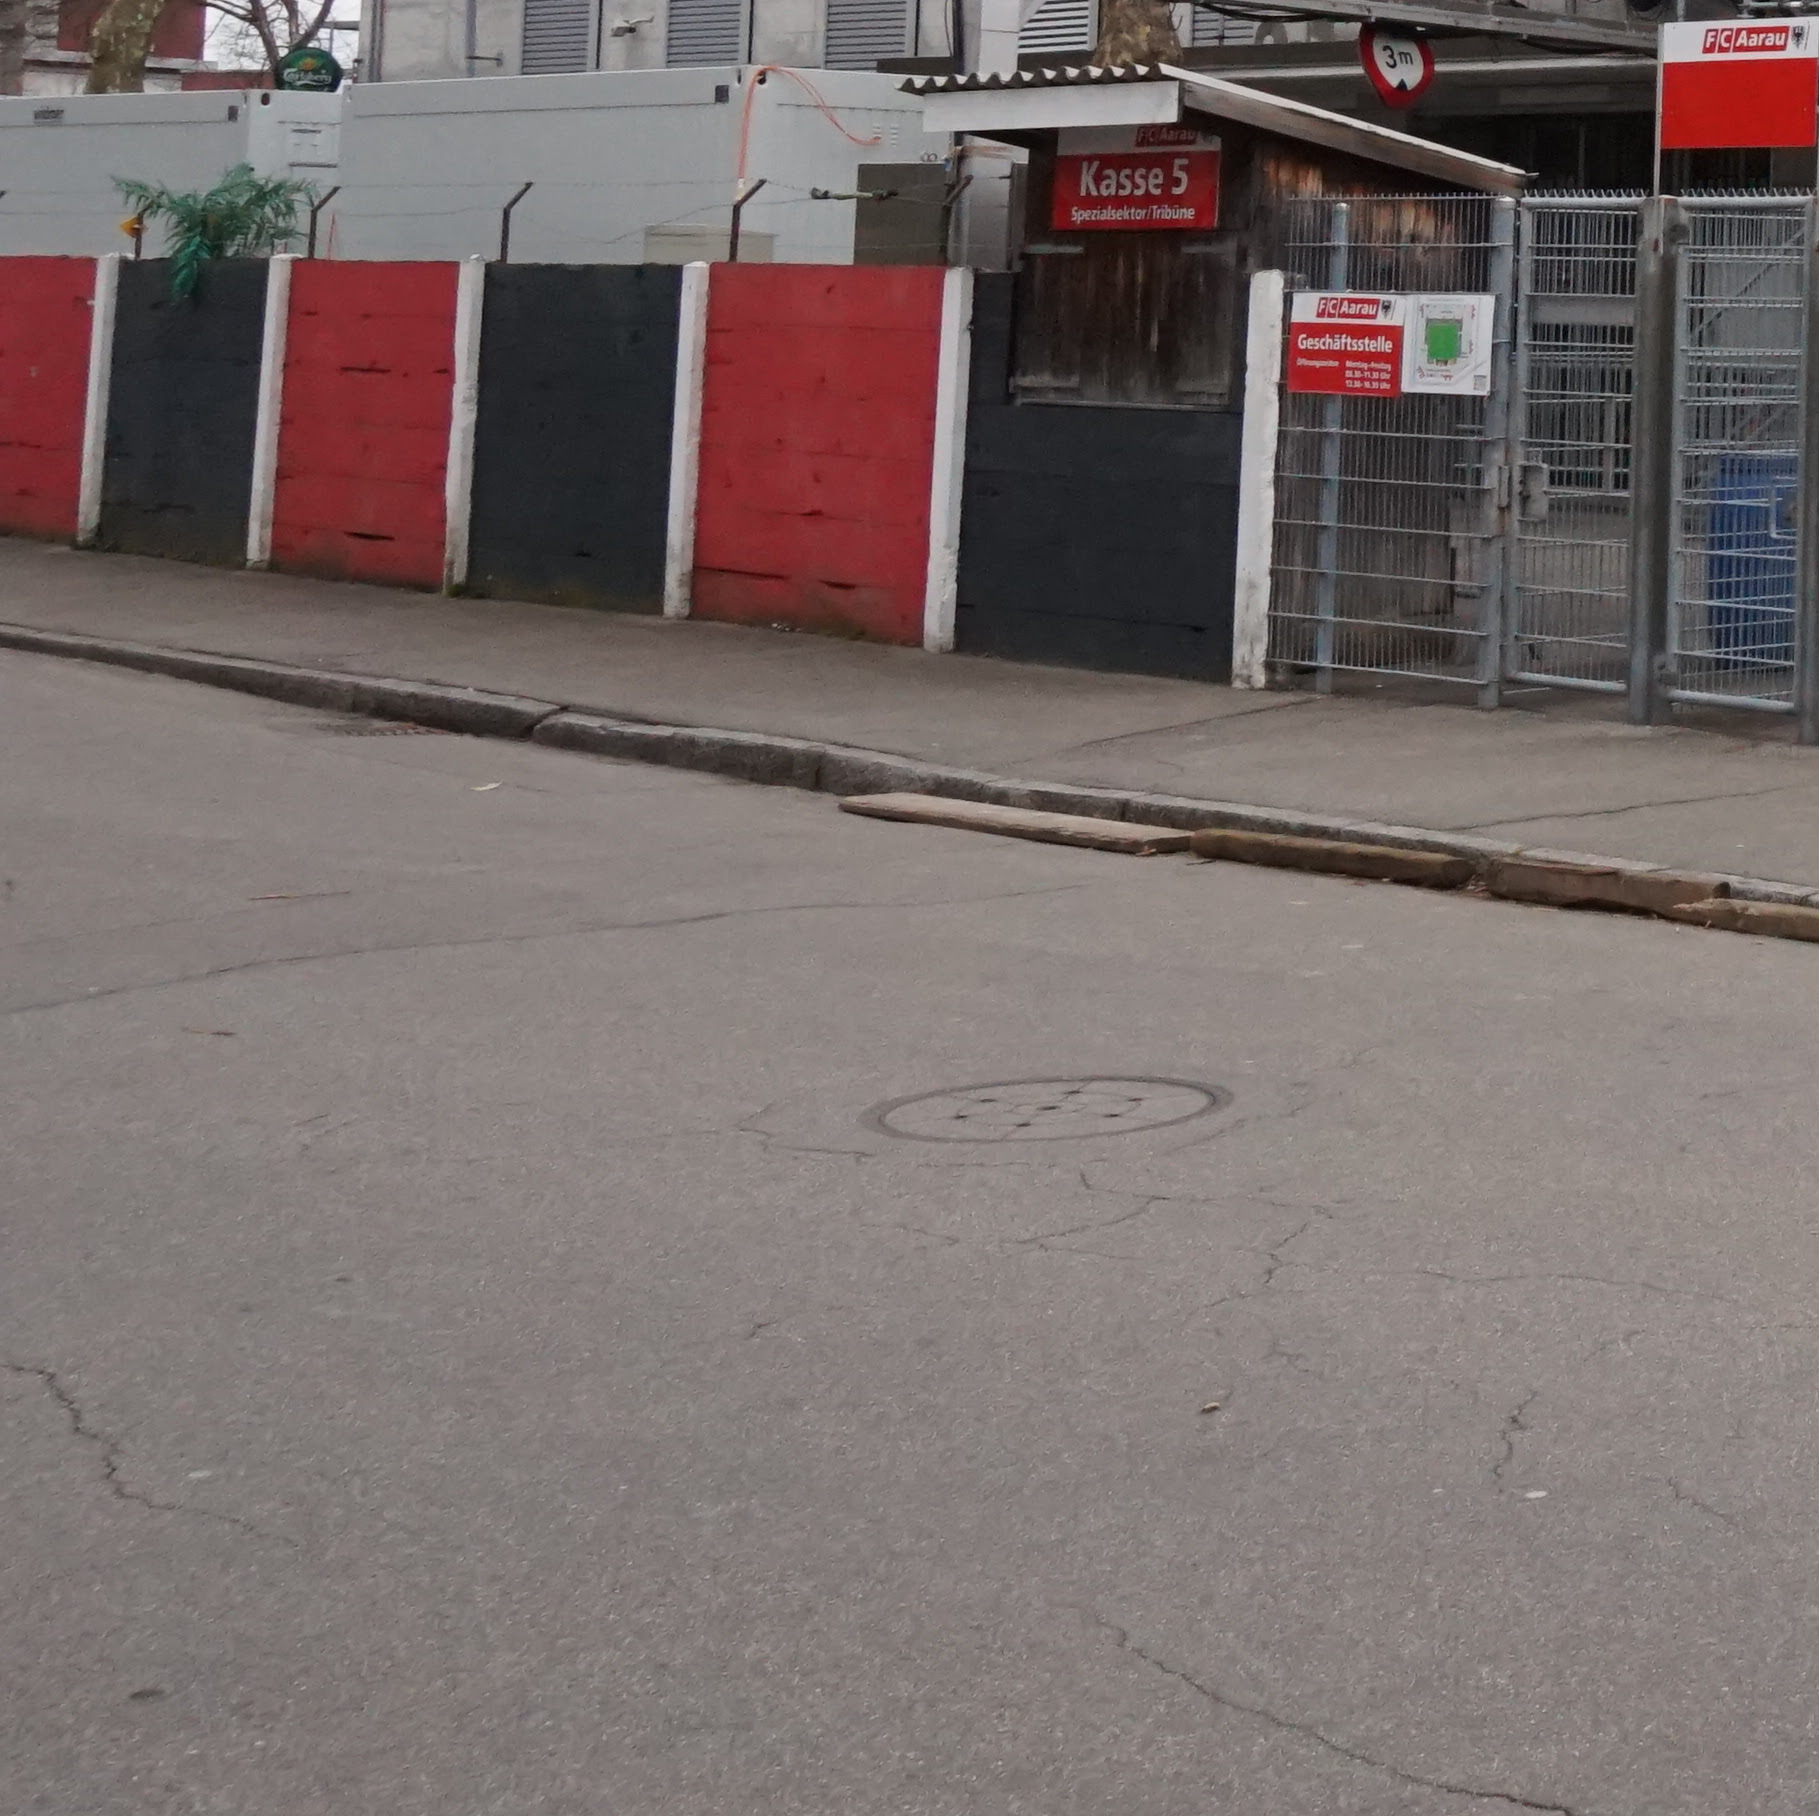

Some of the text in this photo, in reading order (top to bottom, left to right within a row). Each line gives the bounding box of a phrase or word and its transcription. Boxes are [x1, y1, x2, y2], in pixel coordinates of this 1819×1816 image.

[1080, 157, 1189, 197] Kasse 5
[1071, 205, 1195, 224] Spezialsektor/Tribüne
[1340, 300, 1377, 315] Aarau
[1298, 334, 1393, 353] Geschäftsstelle
